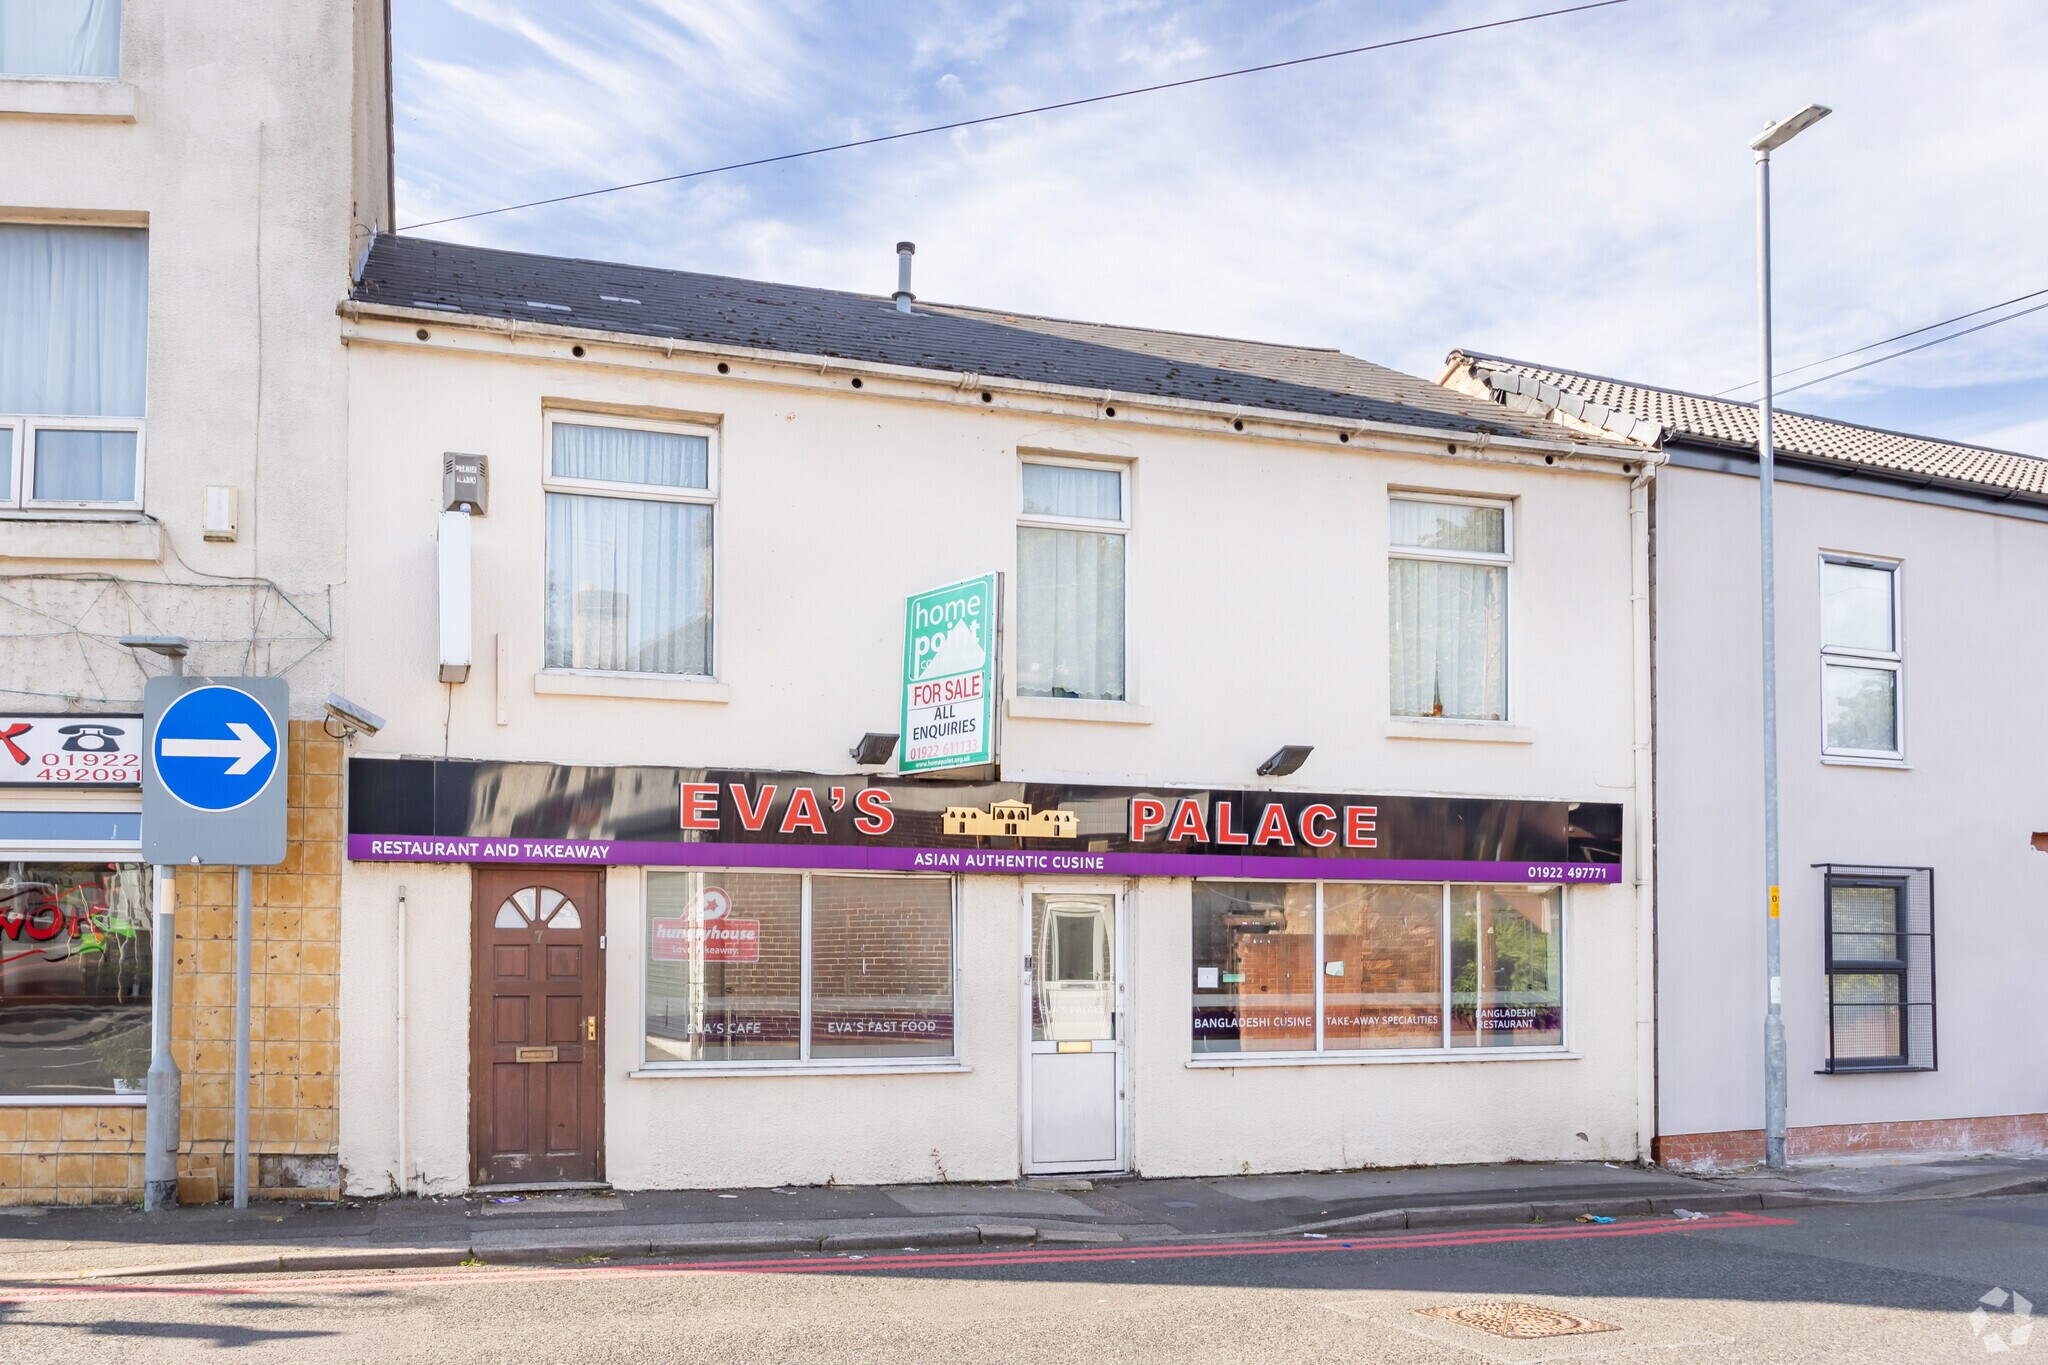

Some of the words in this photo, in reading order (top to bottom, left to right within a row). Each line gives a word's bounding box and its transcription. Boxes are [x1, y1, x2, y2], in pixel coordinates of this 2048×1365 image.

[915, 595, 981, 630] home
[914, 682, 941, 706] FOR
[945, 675, 980, 701] SALE
[934, 705, 956, 720] ALL
[913, 718, 976, 740] ENQUIRIES
[910, 744, 939, 760] 01922
[943, 739, 978, 756] 611133
[41, 753, 139, 766] 01922
[915, 755, 971, 768] www.homepoint.org.uk
[36, 768, 141, 781] 492091
[680, 783, 895, 835] EVA'S
[1128, 798, 1378, 848] PALACE
[371, 840, 479, 856] RESTAURANT
[484, 844, 519, 857] AND
[523, 844, 610, 858] TAKEAWAY
[914, 853, 960, 866] ASIAN
[965, 854, 1048, 868] AUTHENTIC
[1052, 856, 1104, 869] CUSINE
[1528, 866, 1563, 878] 01922
[1567, 867, 1606, 879] 497771
[534, 930, 544, 944] 7
[694, 946, 739, 956] keaway.
[828, 1021, 864, 1033] EVA'S
[868, 1021, 898, 1032] FAST
[901, 1020, 936, 1032] FOOD
[1194, 1017, 1270, 1028] BANGLADESHI
[1273, 1016, 1312, 1027] CUSINE
[1326, 1016, 1380, 1025] TAKE-AWAY
[1382, 1016, 1438, 1025] SPECIALITIES
[1477, 1019, 1533, 1029] RESTAURANT
[727, 1022, 761, 1034] CAFE
